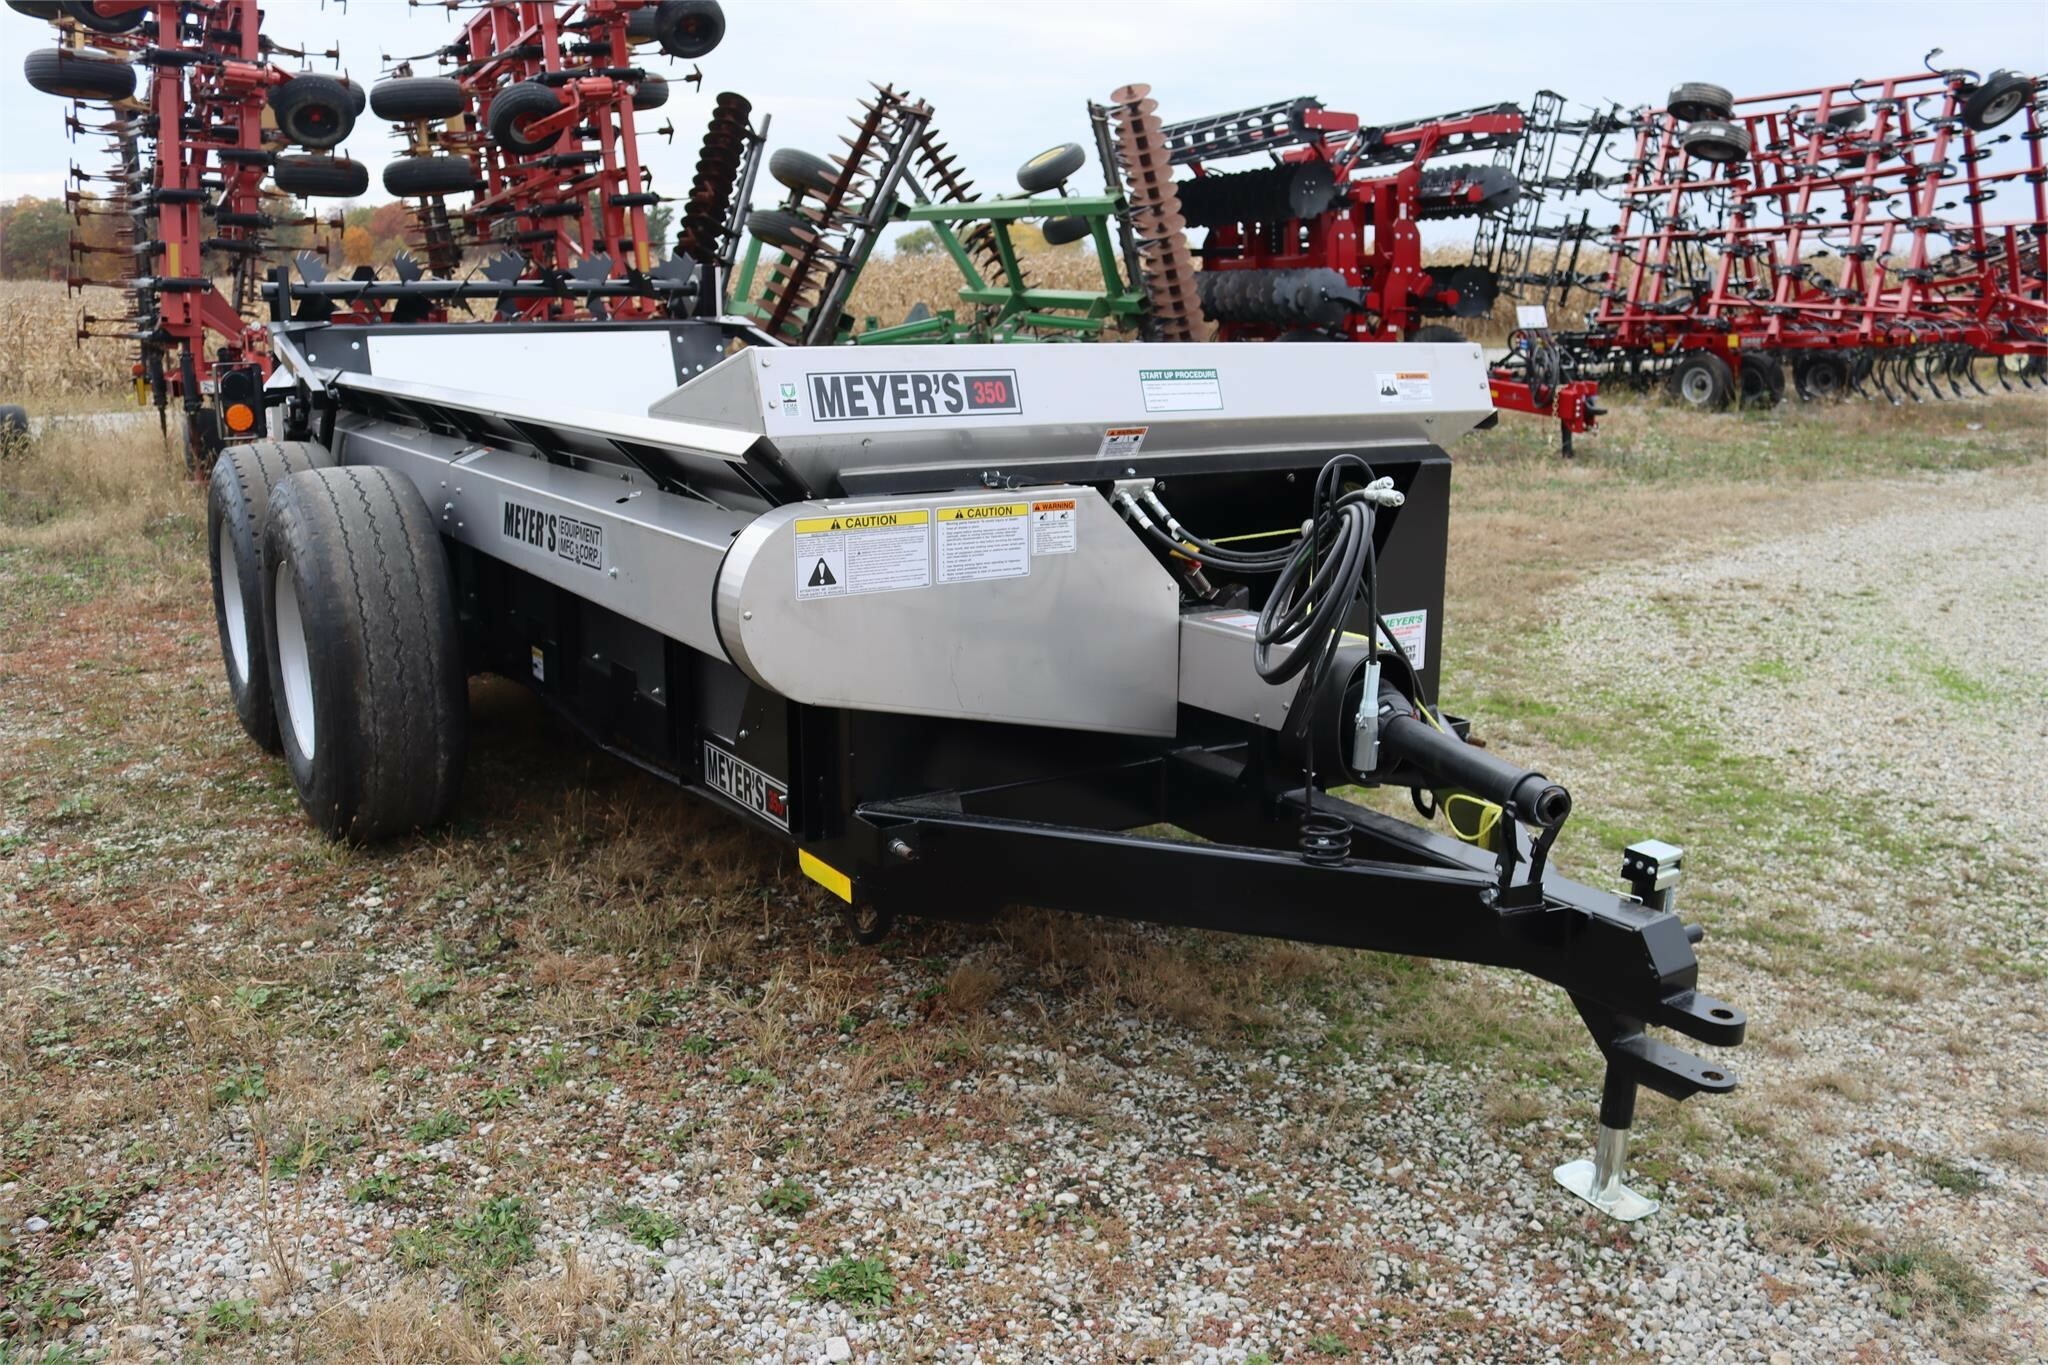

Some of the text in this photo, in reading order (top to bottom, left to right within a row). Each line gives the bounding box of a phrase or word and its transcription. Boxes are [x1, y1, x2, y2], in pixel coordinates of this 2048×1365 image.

[1140, 370, 1217, 380] START UP PROCEDURE
[813, 373, 1007, 418] MEYER'S 350
[967, 506, 1013, 518] CAUTION
[1042, 501, 1074, 510] WARNING
[503, 501, 600, 552] MEYER'S EQUIPMENT
[845, 515, 897, 528] CAUTION
[707, 747, 765, 812] MEYER'S
